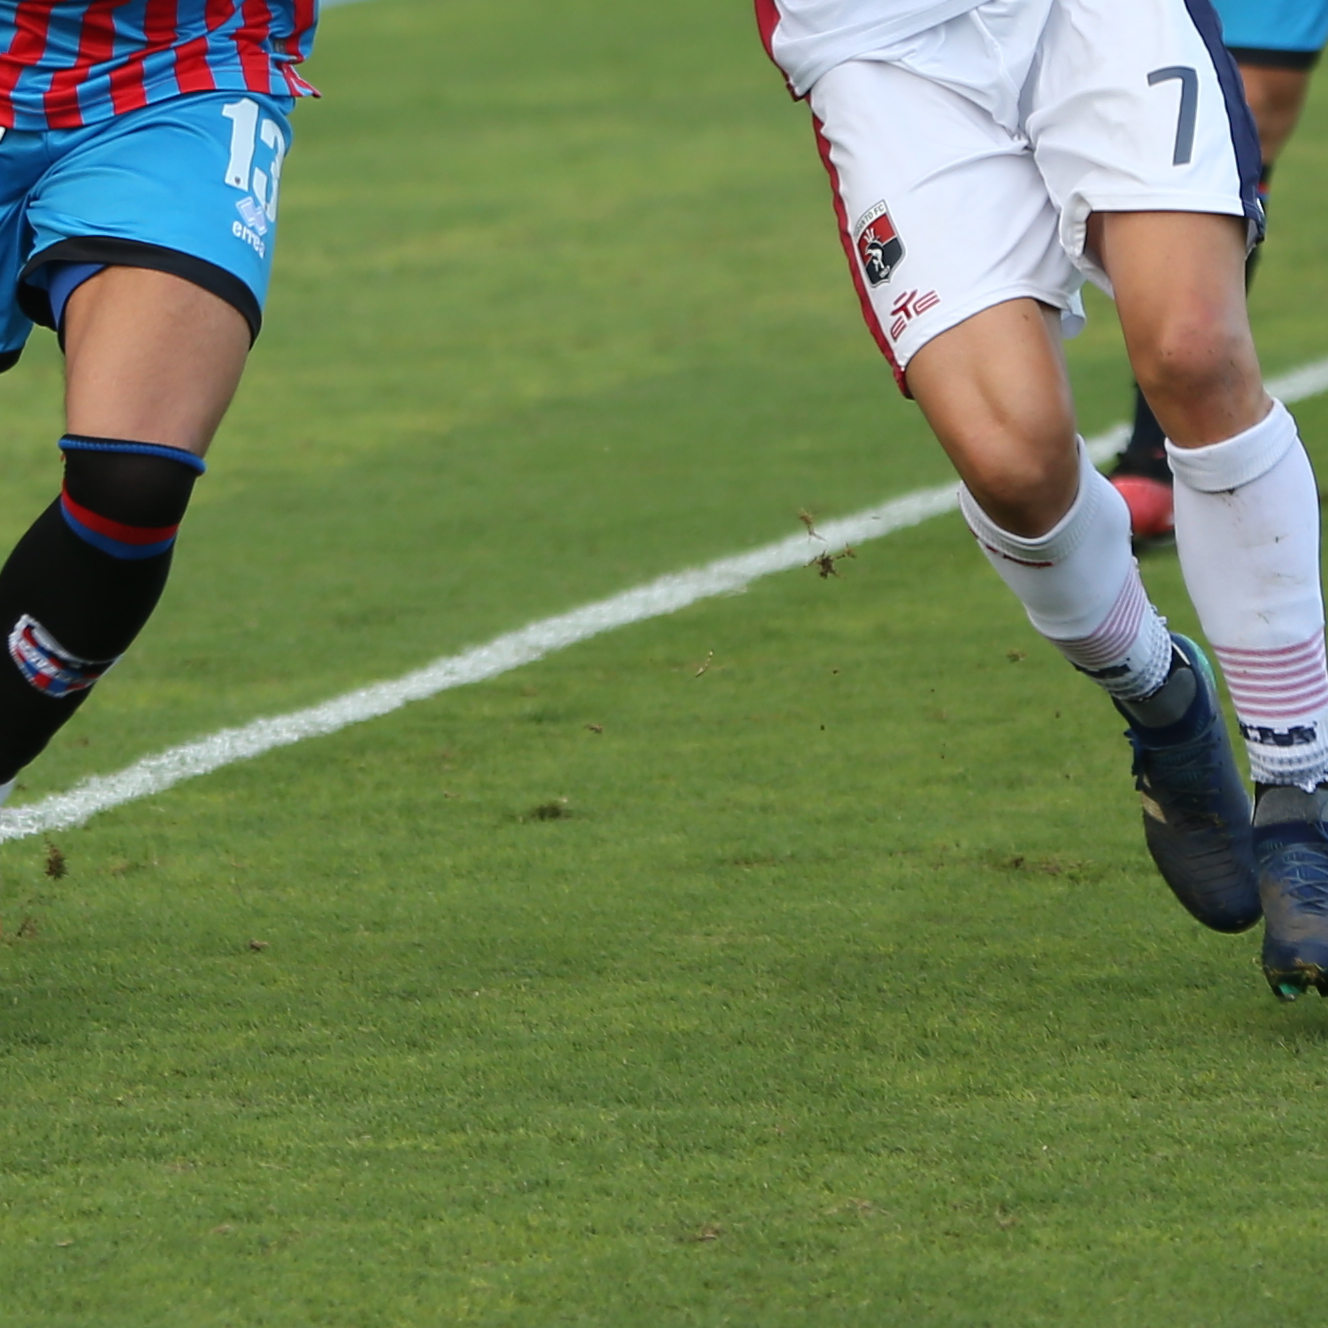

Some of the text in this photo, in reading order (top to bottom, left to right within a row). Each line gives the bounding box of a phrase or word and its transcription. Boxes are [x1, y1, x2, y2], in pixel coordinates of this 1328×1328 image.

[222, 97, 285, 223] 13
[1146, 65, 1199, 166] 7
[232, 220, 266, 260] errea
